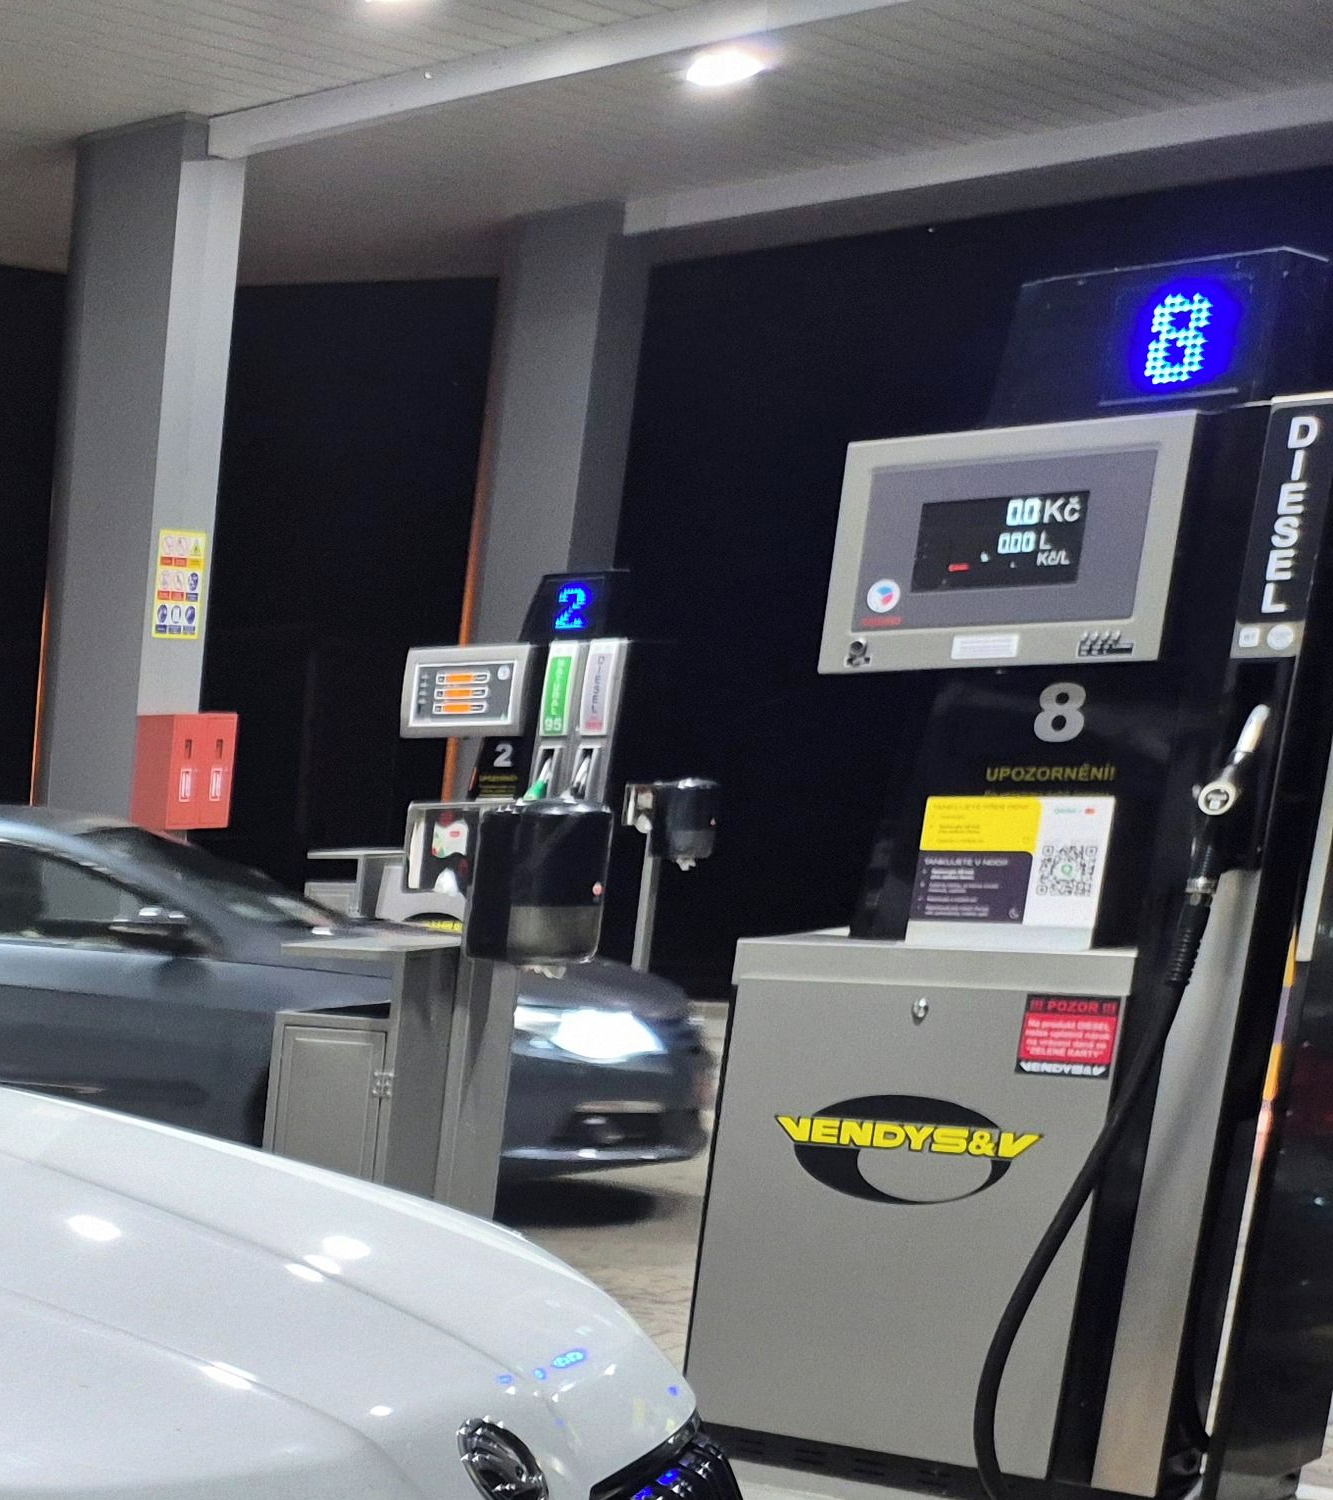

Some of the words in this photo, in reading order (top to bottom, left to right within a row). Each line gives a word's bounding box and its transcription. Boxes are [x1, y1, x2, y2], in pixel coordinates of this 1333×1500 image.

[1144, 292, 1213, 385] 8
[1043, 496, 1081, 524] Kč
[1261, 416, 1318, 614] DIESEL
[1039, 530, 1052, 550] L
[1036, 550, 1071, 567] Kč/L
[554, 587, 587, 630] 2
[591, 655, 605, 714] DIESEL
[544, 718, 562, 732] 95
[1033, 682, 1087, 743] 8
[493, 743, 513, 767] 2
[986, 763, 1116, 782] UPOZORNĚNÍ!
[1047, 999, 1099, 1014] POZOR
[776, 1115, 1043, 1160] VENDYS&V
